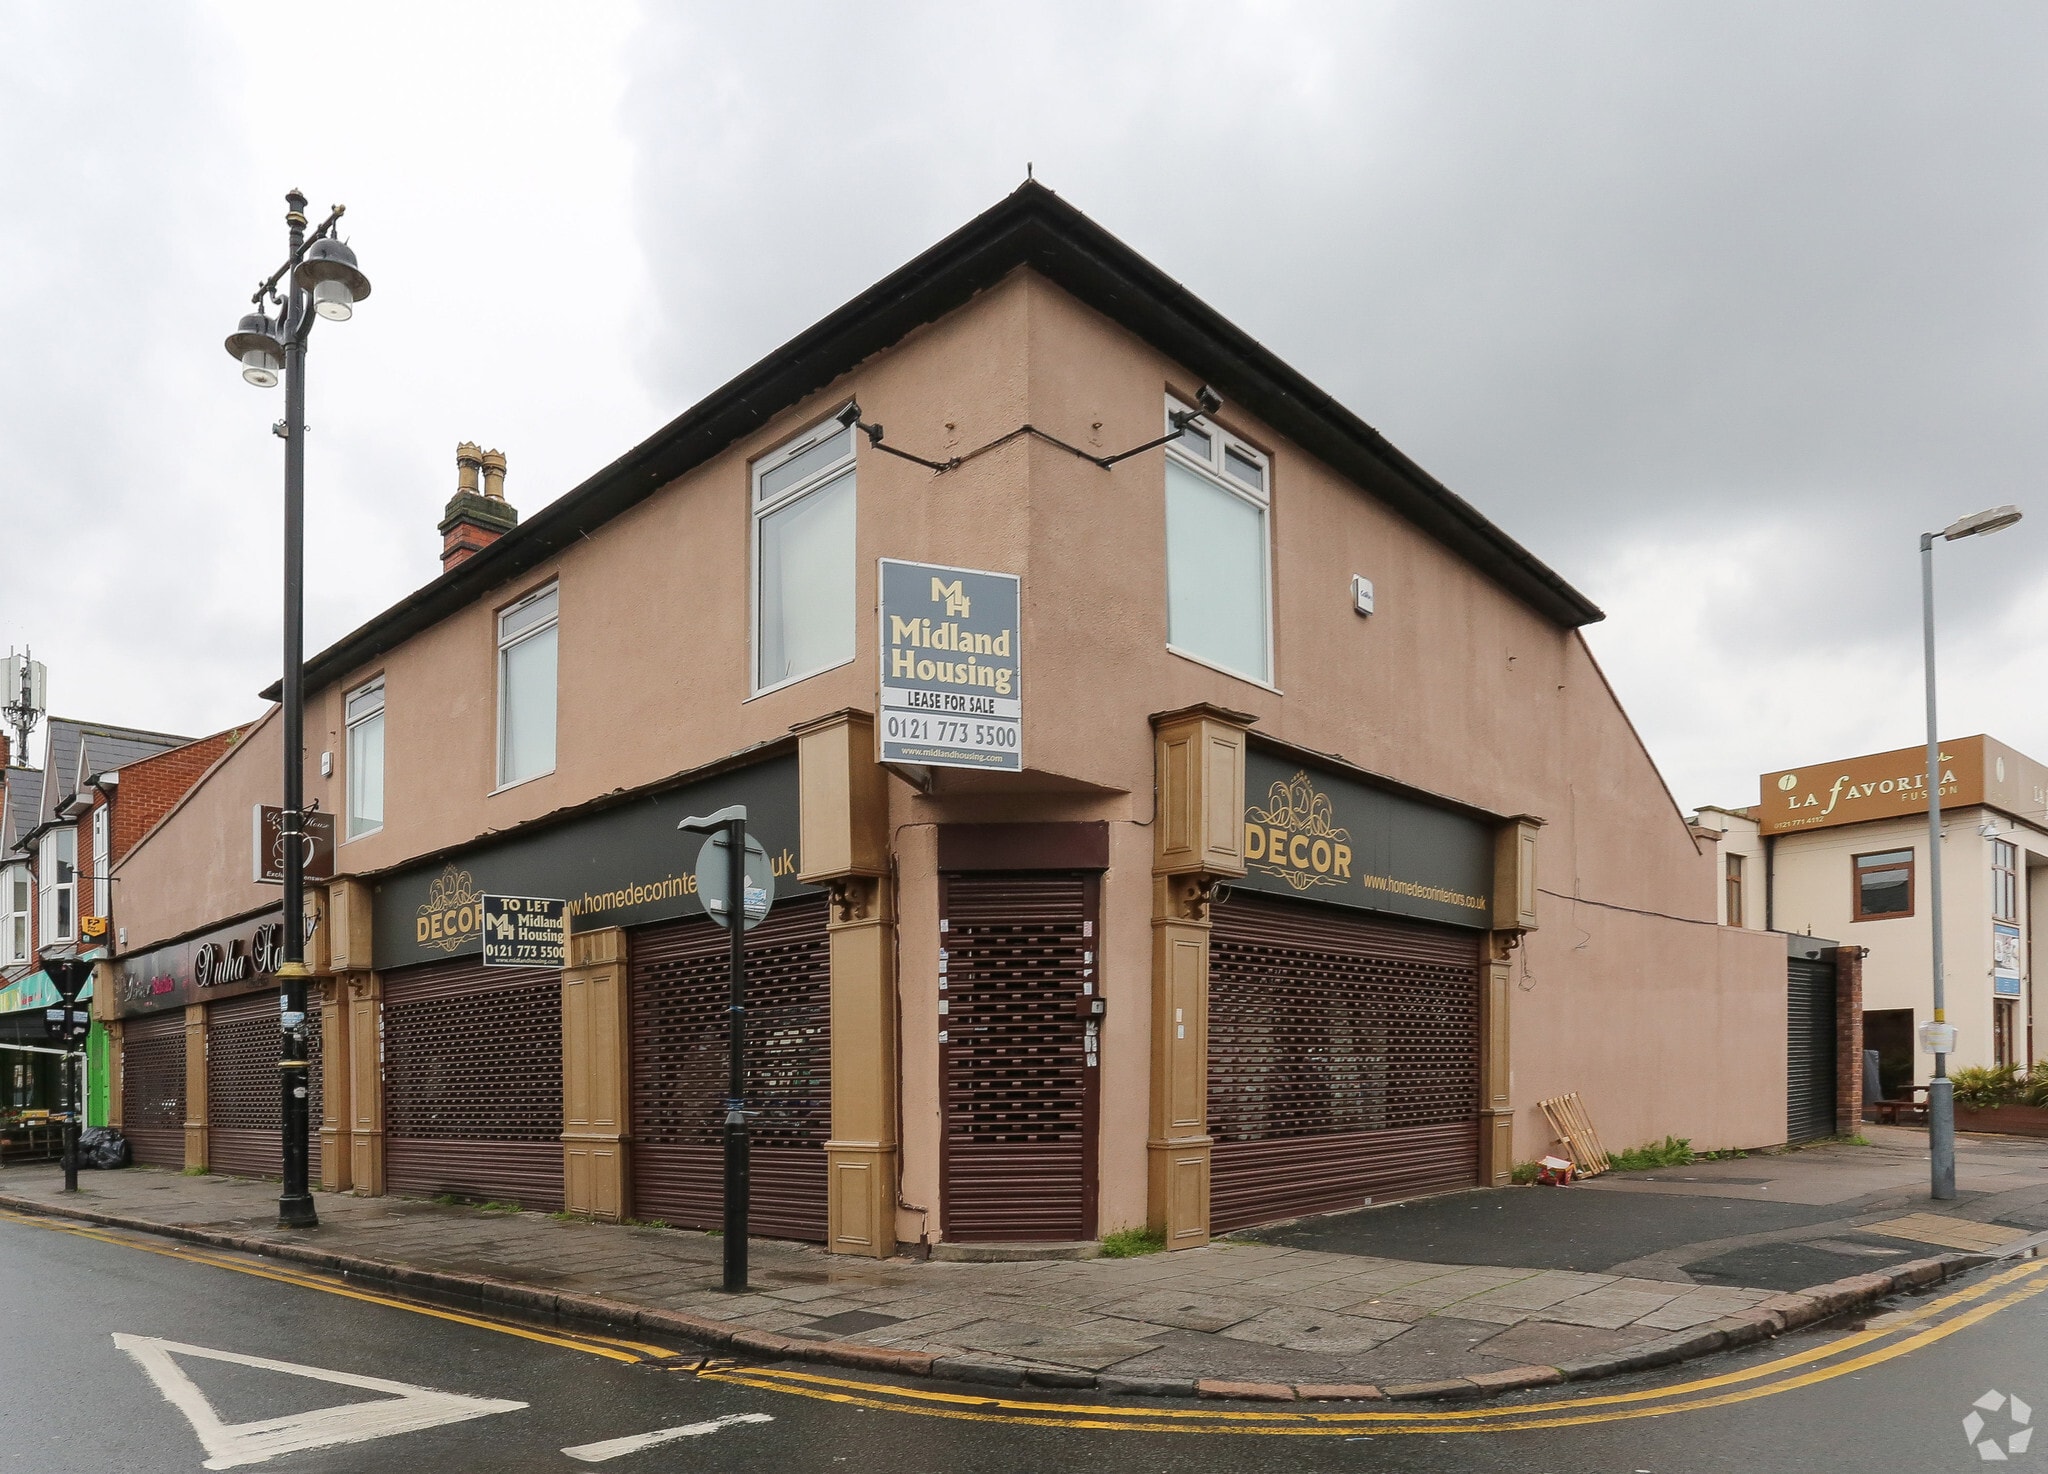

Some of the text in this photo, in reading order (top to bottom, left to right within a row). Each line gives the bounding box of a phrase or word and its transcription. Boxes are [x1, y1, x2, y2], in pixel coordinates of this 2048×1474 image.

[890, 615, 1010, 657] Midland
[892, 648, 1012, 695] Housing
[908, 691, 995, 714] LEASE FOR SALE
[888, 716, 1016, 748] 0121 773 5500
[902, 747, 1003, 762] www.midlandhousing.com
[1788, 793, 1819, 809] LA
[1821, 770, 1957, 815] fAVORIA
[1901, 785, 1958, 801] FUSON
[1774, 821, 1791, 829] 0121
[1244, 822, 1352, 878] DECOR
[1364, 874, 1486, 911] www.homedecorinteriors.co.uk
[501, 898, 550, 913] TO LET
[517, 913, 563, 929] Midland
[518, 928, 564, 944] Housing
[486, 944, 564, 958] 0121 773 5500
[195, 942, 245, 988] Dulha
